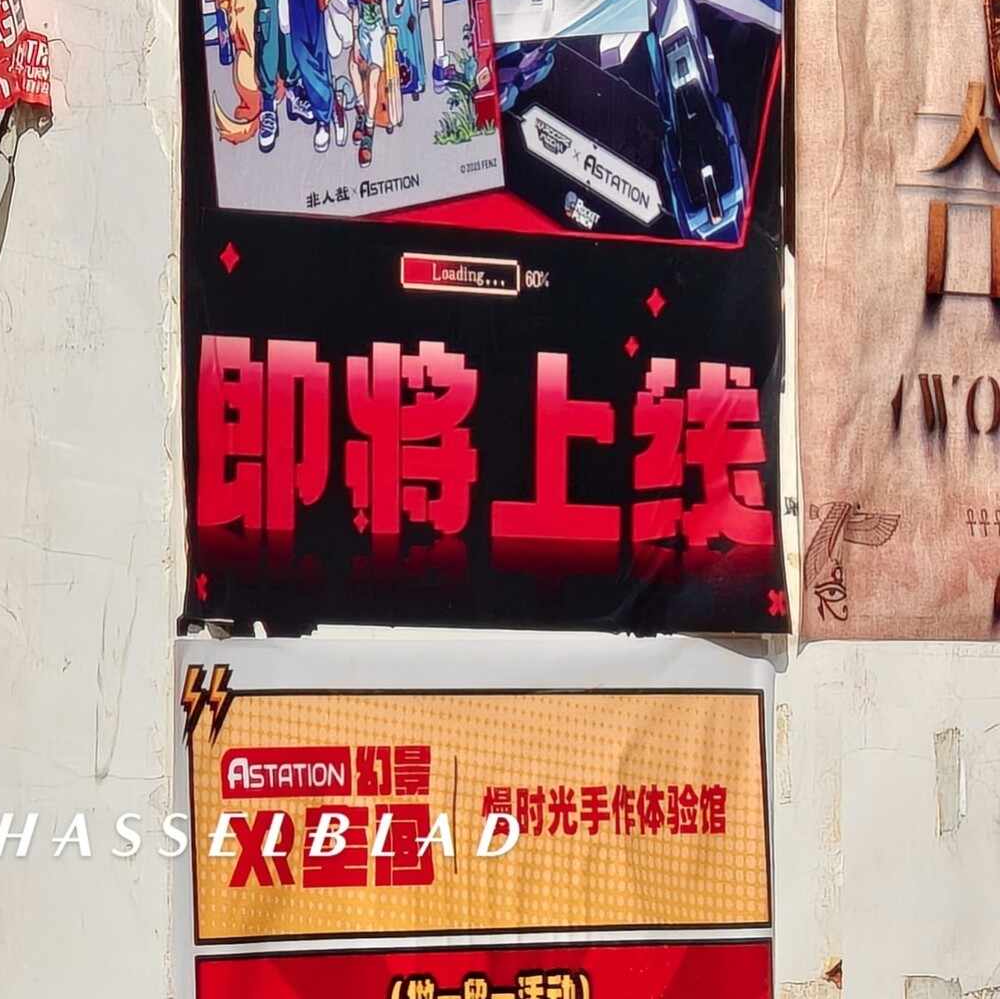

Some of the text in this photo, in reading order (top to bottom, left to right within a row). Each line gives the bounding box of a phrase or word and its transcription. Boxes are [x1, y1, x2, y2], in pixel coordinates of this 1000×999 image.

[359, 173, 421, 199] ASTATION
[583, 154, 650, 209] ASTATION
[524, 269, 551, 289] 60%
[197, 334, 775, 547] 即将上线
[226, 756, 346, 790] ASTATION
